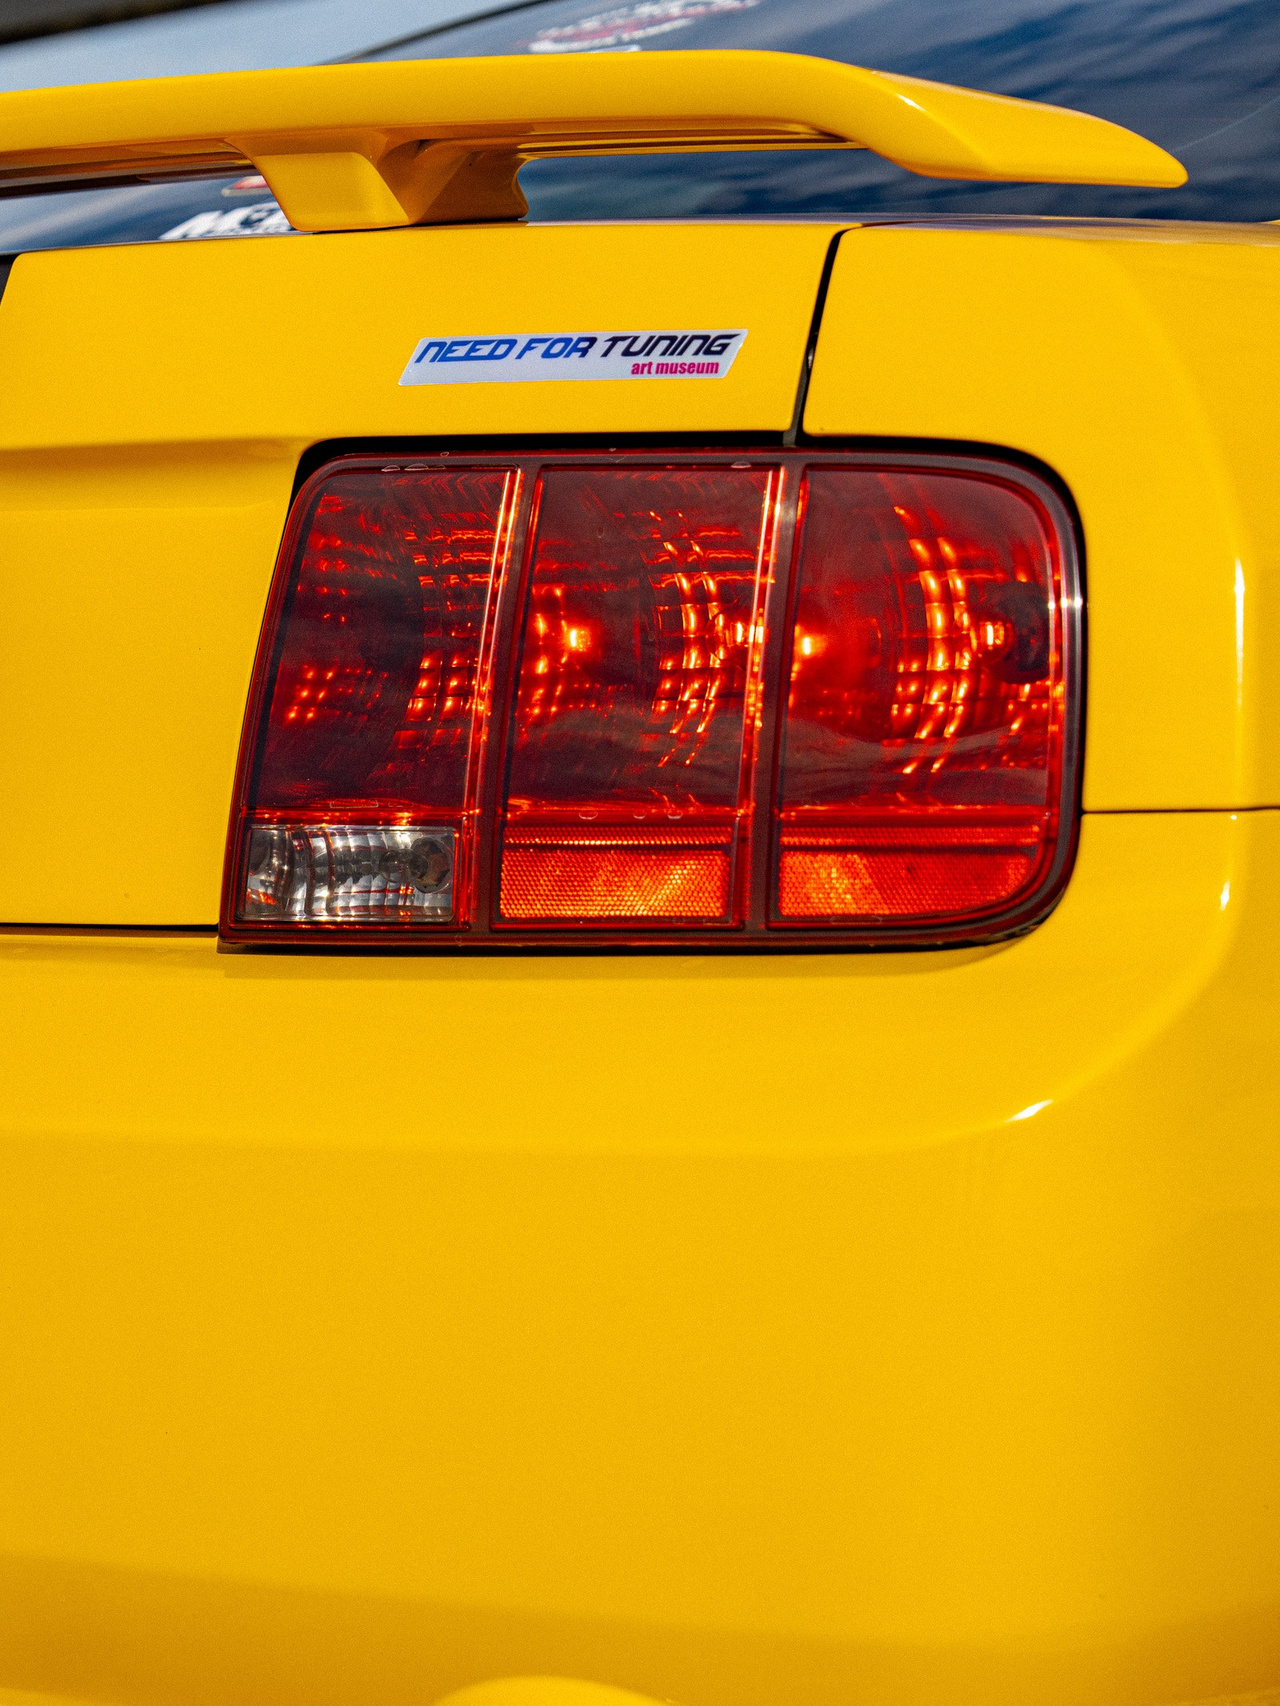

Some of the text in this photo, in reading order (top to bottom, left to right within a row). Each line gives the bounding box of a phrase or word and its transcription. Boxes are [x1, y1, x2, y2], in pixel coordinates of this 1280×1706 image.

[414, 332, 741, 364] NEED FOR TUNING
[631, 360, 720, 376] art museum
